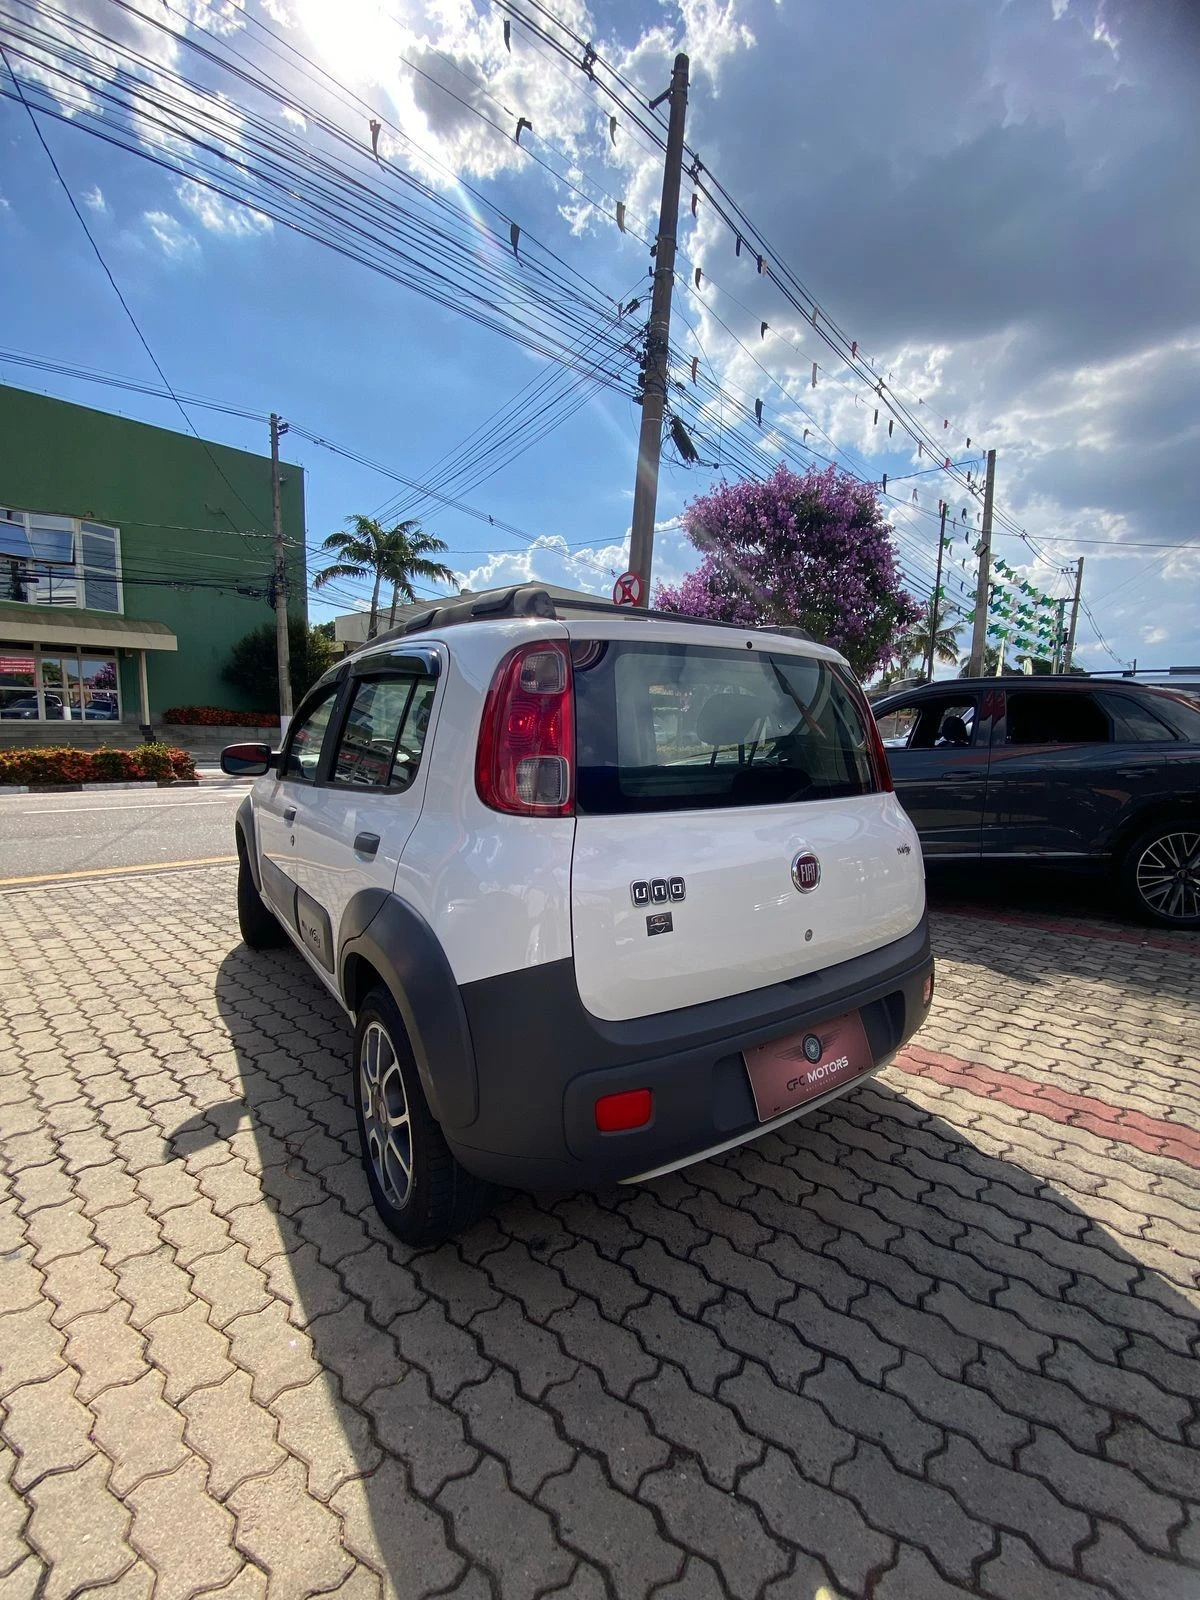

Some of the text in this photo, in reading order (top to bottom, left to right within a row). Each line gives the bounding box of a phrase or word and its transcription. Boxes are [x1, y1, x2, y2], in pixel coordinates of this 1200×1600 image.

[800, 862, 816, 882] FIAT
[786, 1075, 806, 1092] CFC
[806, 1055, 849, 1084] MOTORS
